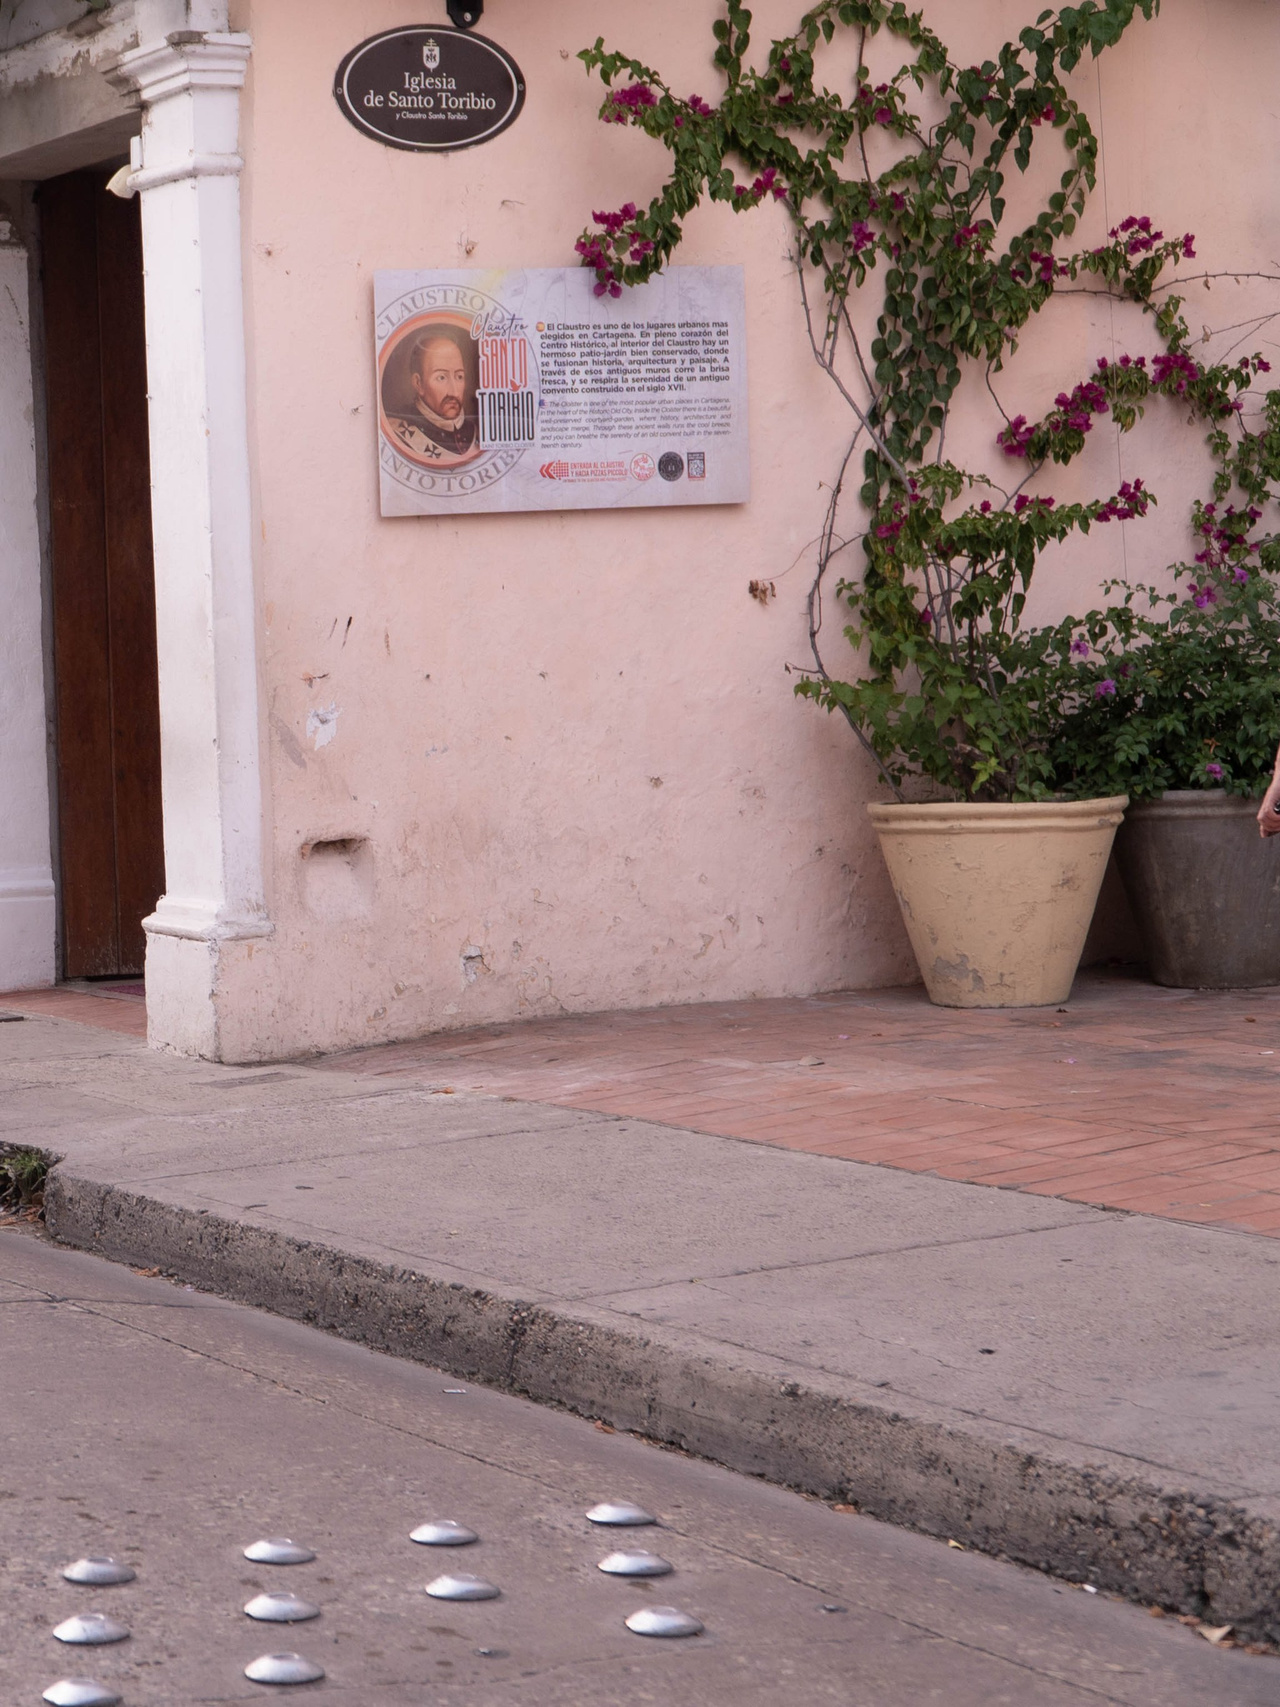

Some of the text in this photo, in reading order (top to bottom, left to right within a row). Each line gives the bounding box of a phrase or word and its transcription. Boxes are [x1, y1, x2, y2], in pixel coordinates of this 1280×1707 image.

[404, 72, 456, 92] Iglesia
[364, 90, 496, 110] de Santo Toribio
[401, 111, 427, 119] Claustro
[428, 112, 446, 120] Santo
[447, 112, 468, 120] Toribio
[377, 289, 485, 341] CLAUSTRO
[646, 321, 676, 331] lugares
[540, 332, 574, 341] elegidos
[654, 330, 677, 339] pleno
[652, 339, 664, 347] del
[701, 339, 716, 348] hay
[580, 349, 627, 359] patio-jardín
[703, 347, 729, 355] donde
[481, 338, 527, 389] SANTO
[628, 357, 677, 367] arquitectura
[607, 367, 641, 376] antiguos
[710, 365, 730, 373] brisa
[591, 376, 619, 386] respira
[632, 375, 671, 383] serenidad
[699, 374, 730, 384] antiguo
[541, 386, 579, 394] convento
[581, 385, 624, 393] construido
[646, 384, 665, 394] siglo
[479, 391, 534, 442] TORIBIO
[441, 449, 515, 492] TORIB
